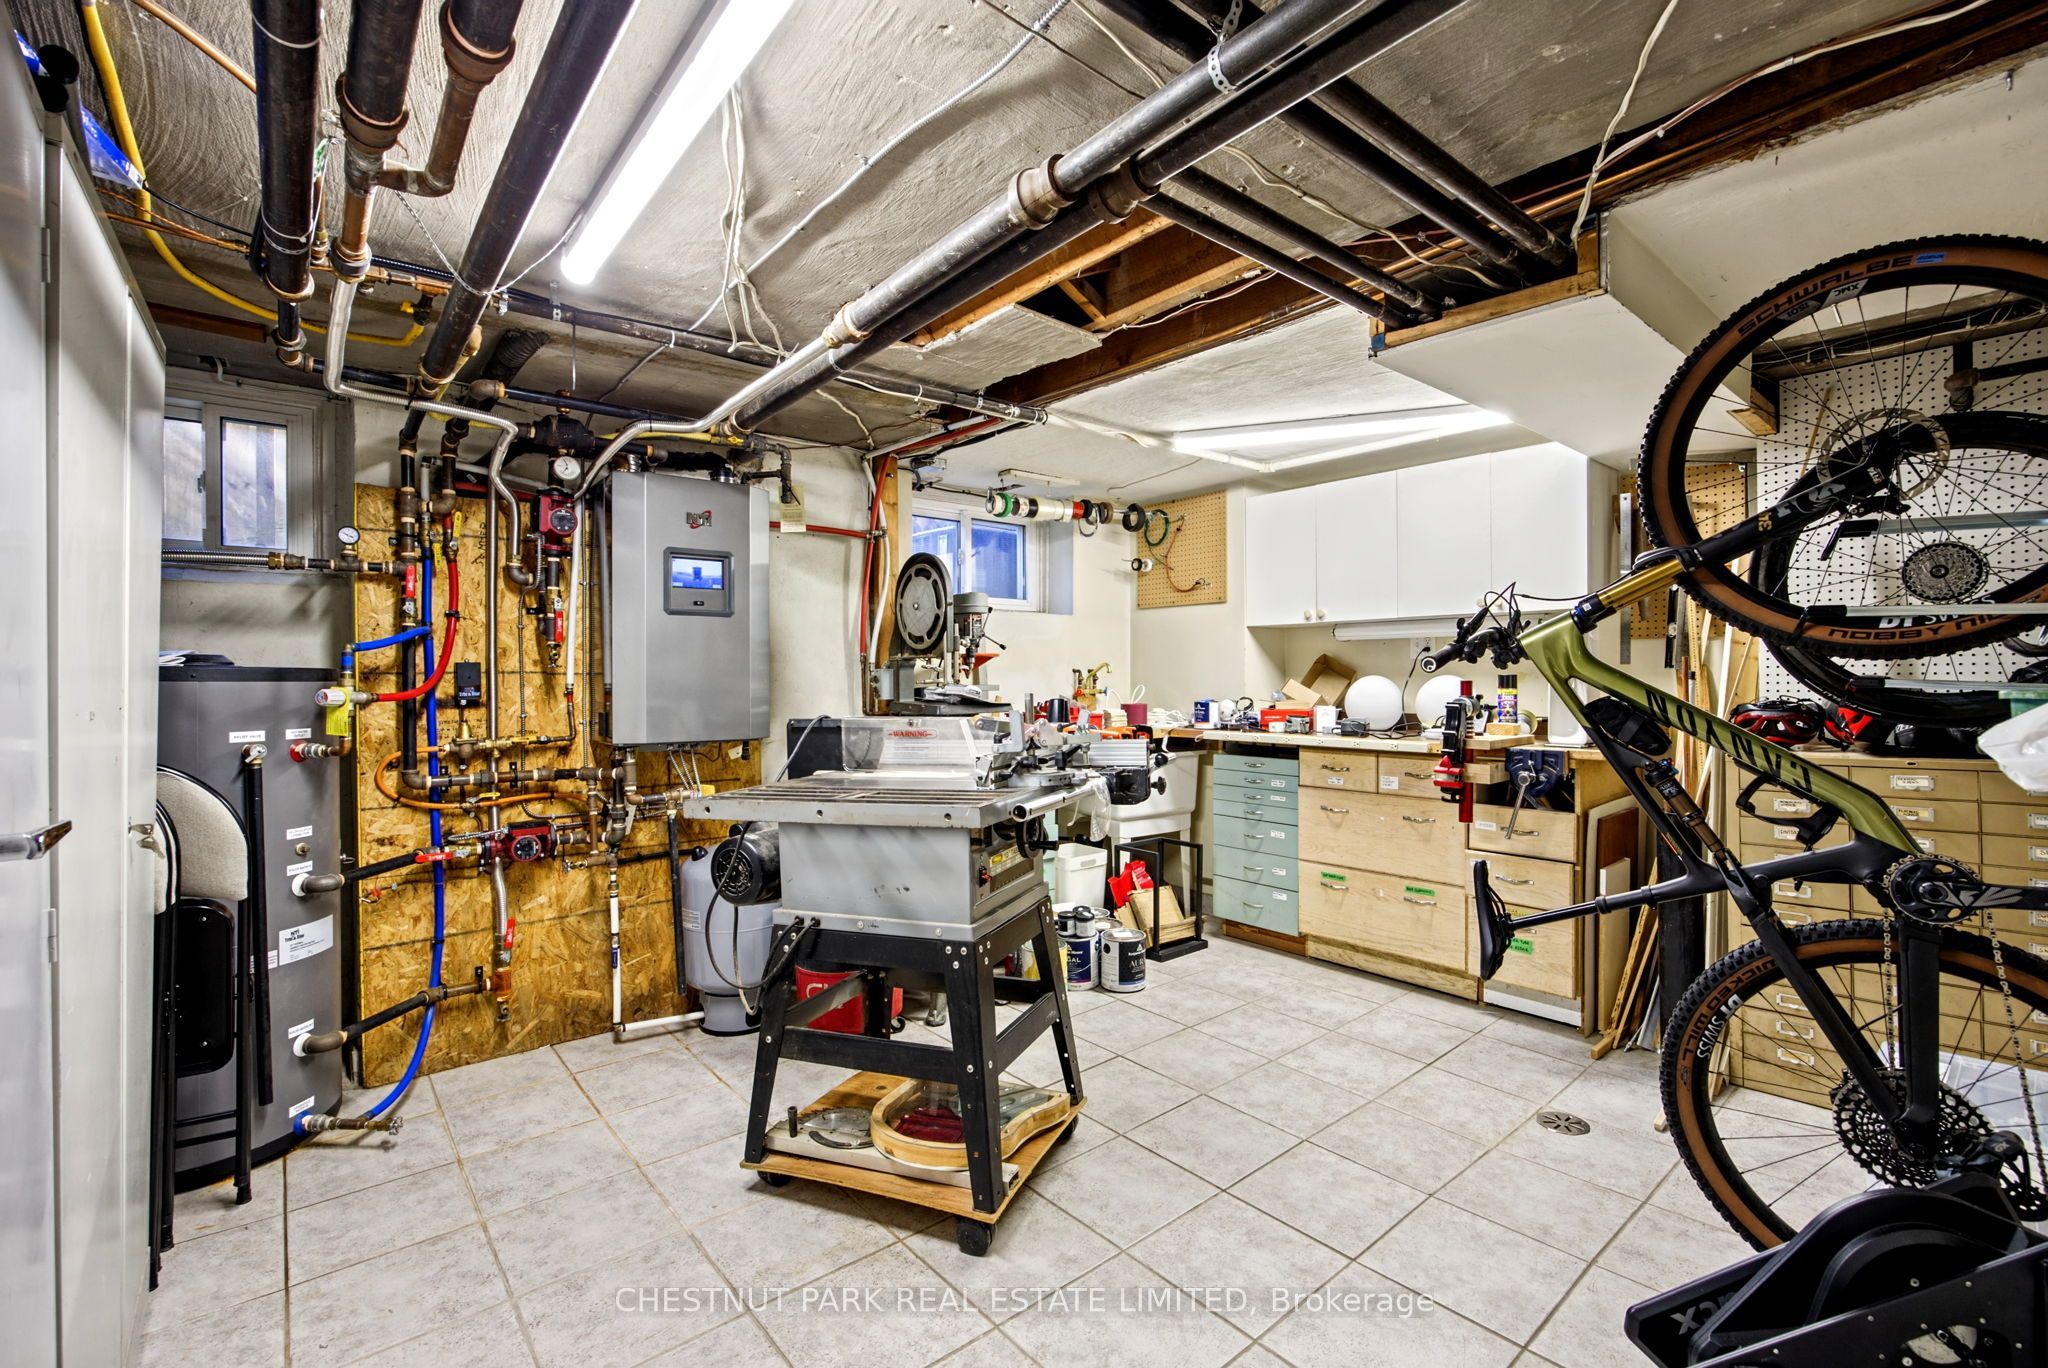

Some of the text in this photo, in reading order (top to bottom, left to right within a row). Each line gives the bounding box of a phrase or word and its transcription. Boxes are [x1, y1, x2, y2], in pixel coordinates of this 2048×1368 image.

[1737, 254, 1914, 336] SCHWALBE
[1833, 282, 1860, 297] XMC
[1828, 625, 1946, 641] NOBBY
[1879, 615, 1914, 629] DT
[893, 730, 928, 738] WARNING
[1644, 687, 1813, 793] CANYON
[1682, 1013, 1709, 1061] WILL
[1697, 993, 1743, 1060] DT SWISS
